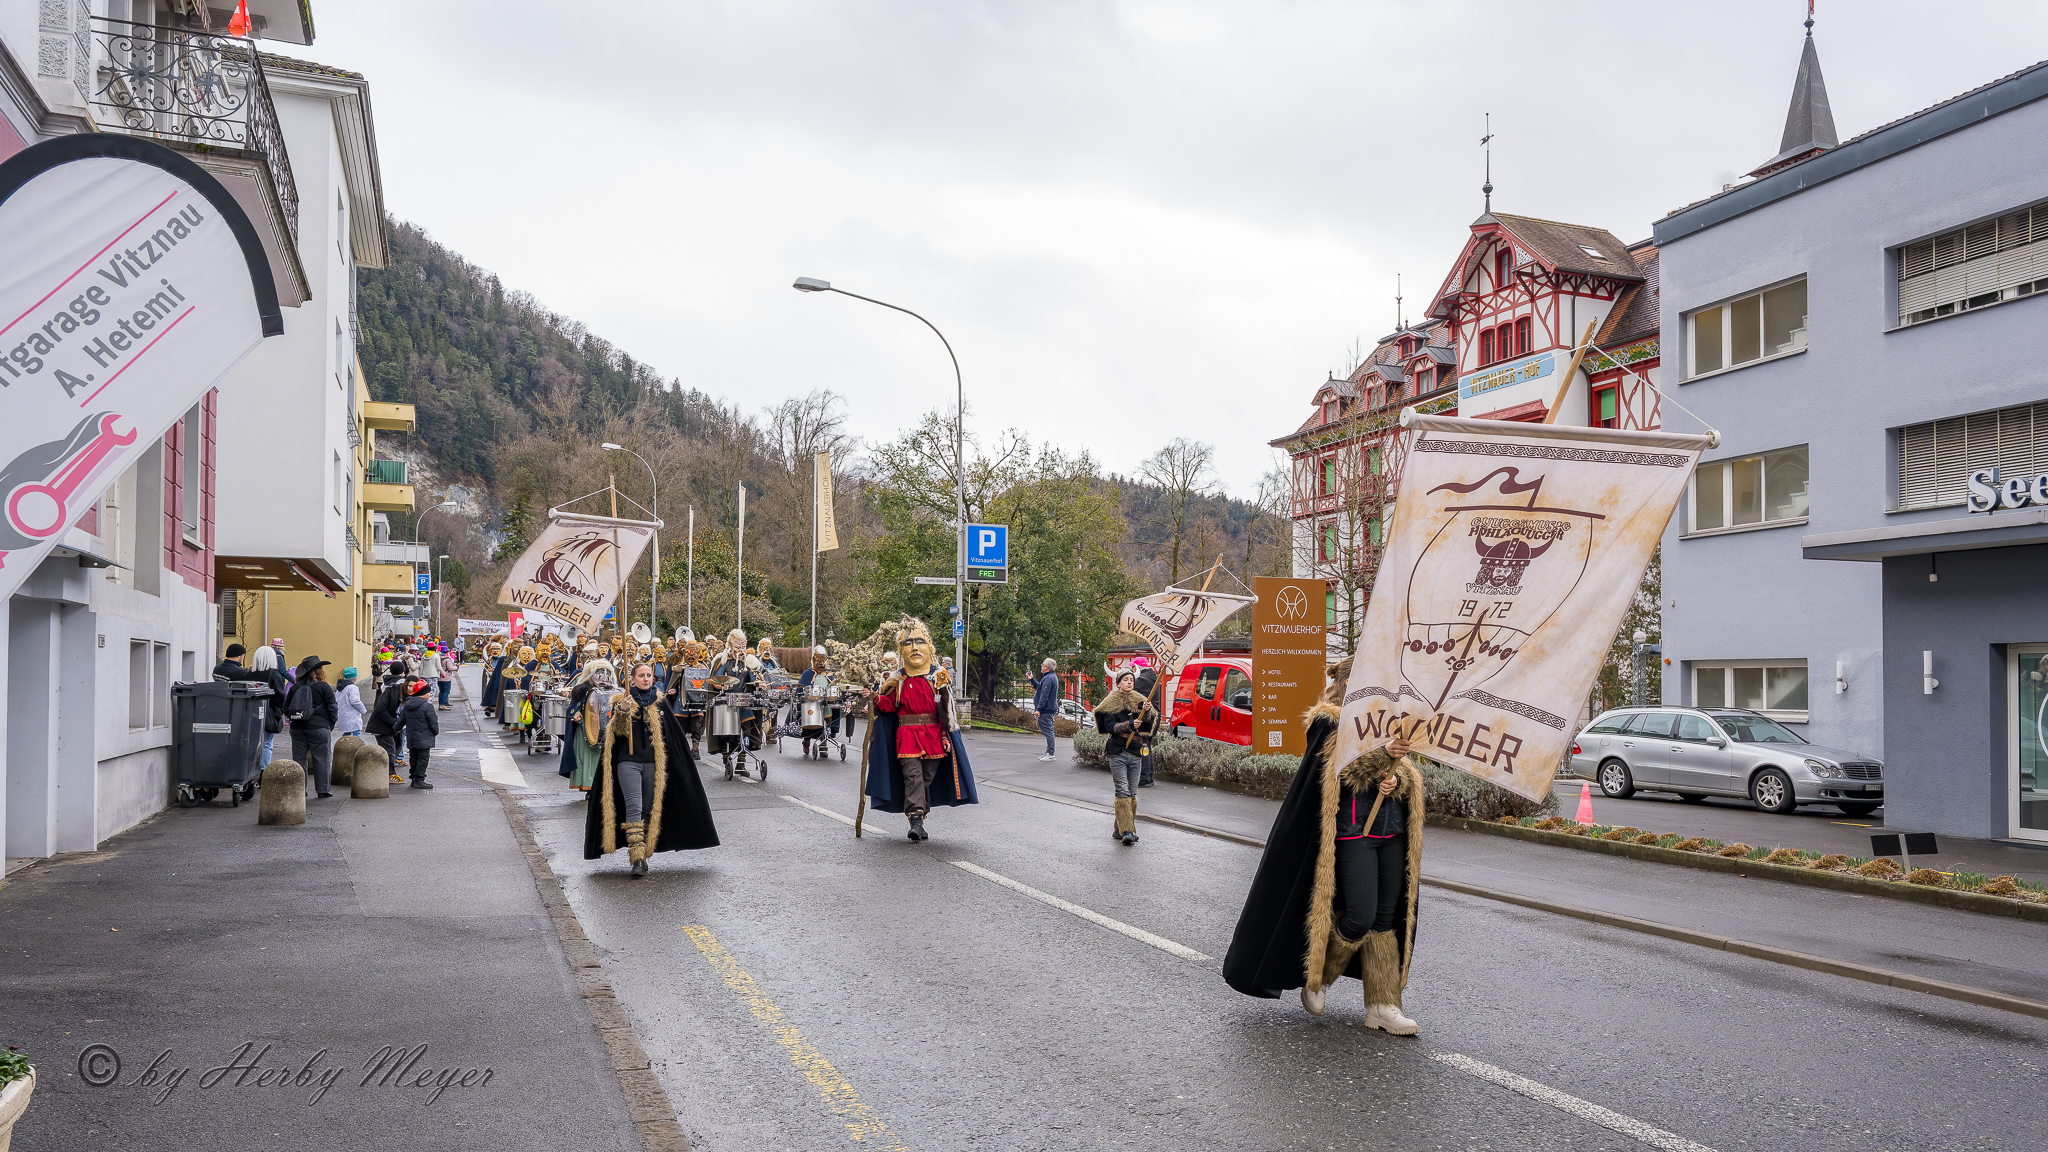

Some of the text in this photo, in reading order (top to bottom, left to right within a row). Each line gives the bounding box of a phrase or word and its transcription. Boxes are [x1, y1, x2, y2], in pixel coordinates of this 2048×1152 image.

[97, 203, 205, 288] Vitznau
[53, 279, 186, 398] A. Hetemi
[1470, 366, 1516, 394] VITZNAUER
[1524, 359, 1541, 379] HOF
[1967, 467, 2048, 514] See
[823, 476, 832, 544] VITZNAUERHOF
[970, 556, 1003, 564] Vitznauerhof
[979, 529, 996, 556] P
[511, 588, 592, 628] WIKINGER
[956, 620, 962, 631] P
[1127, 616, 1180, 666] WIKINGER
[1261, 624, 1322, 635] VITZNAUERHOF
[1287, 648, 1322, 656] WILLKOMMEN
